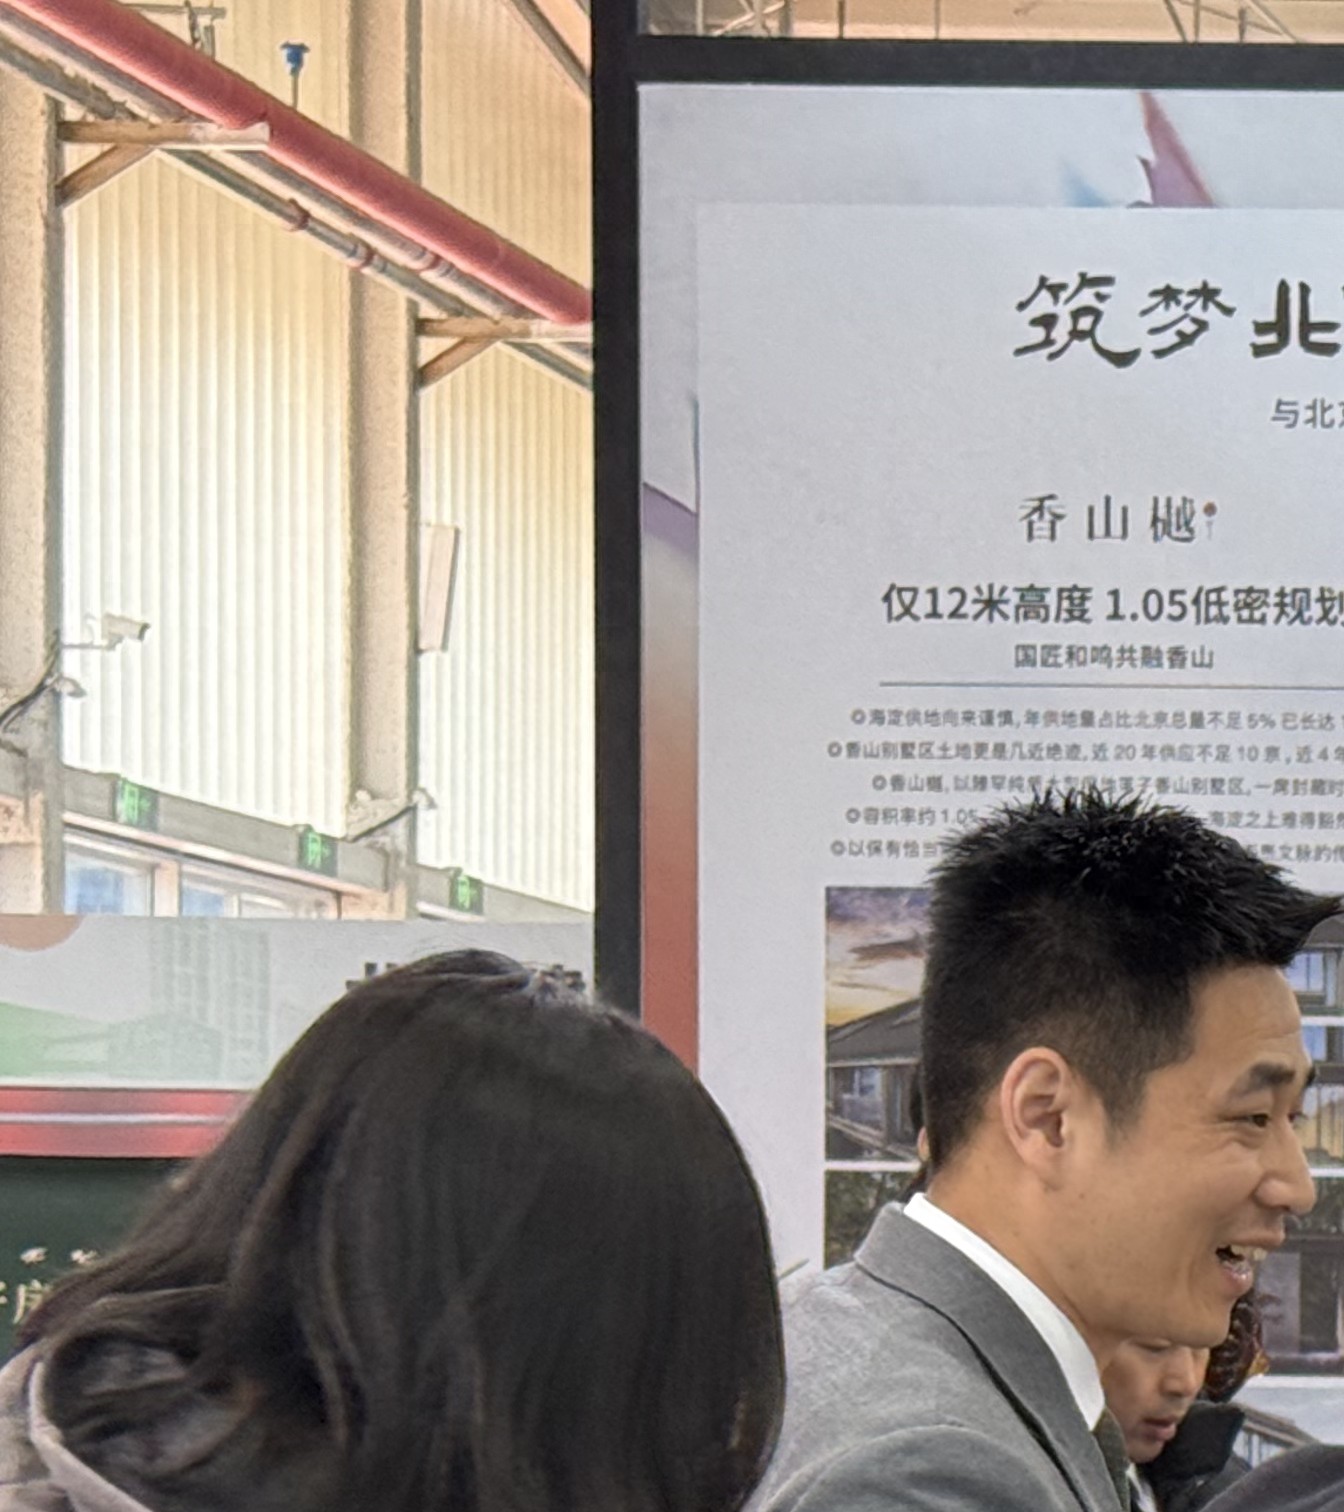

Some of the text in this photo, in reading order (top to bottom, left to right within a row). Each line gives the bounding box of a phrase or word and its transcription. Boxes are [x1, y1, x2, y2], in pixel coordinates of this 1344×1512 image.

[1018, 494, 1197, 543] 香山樾
[882, 583, 1094, 625] 仅12米高度
